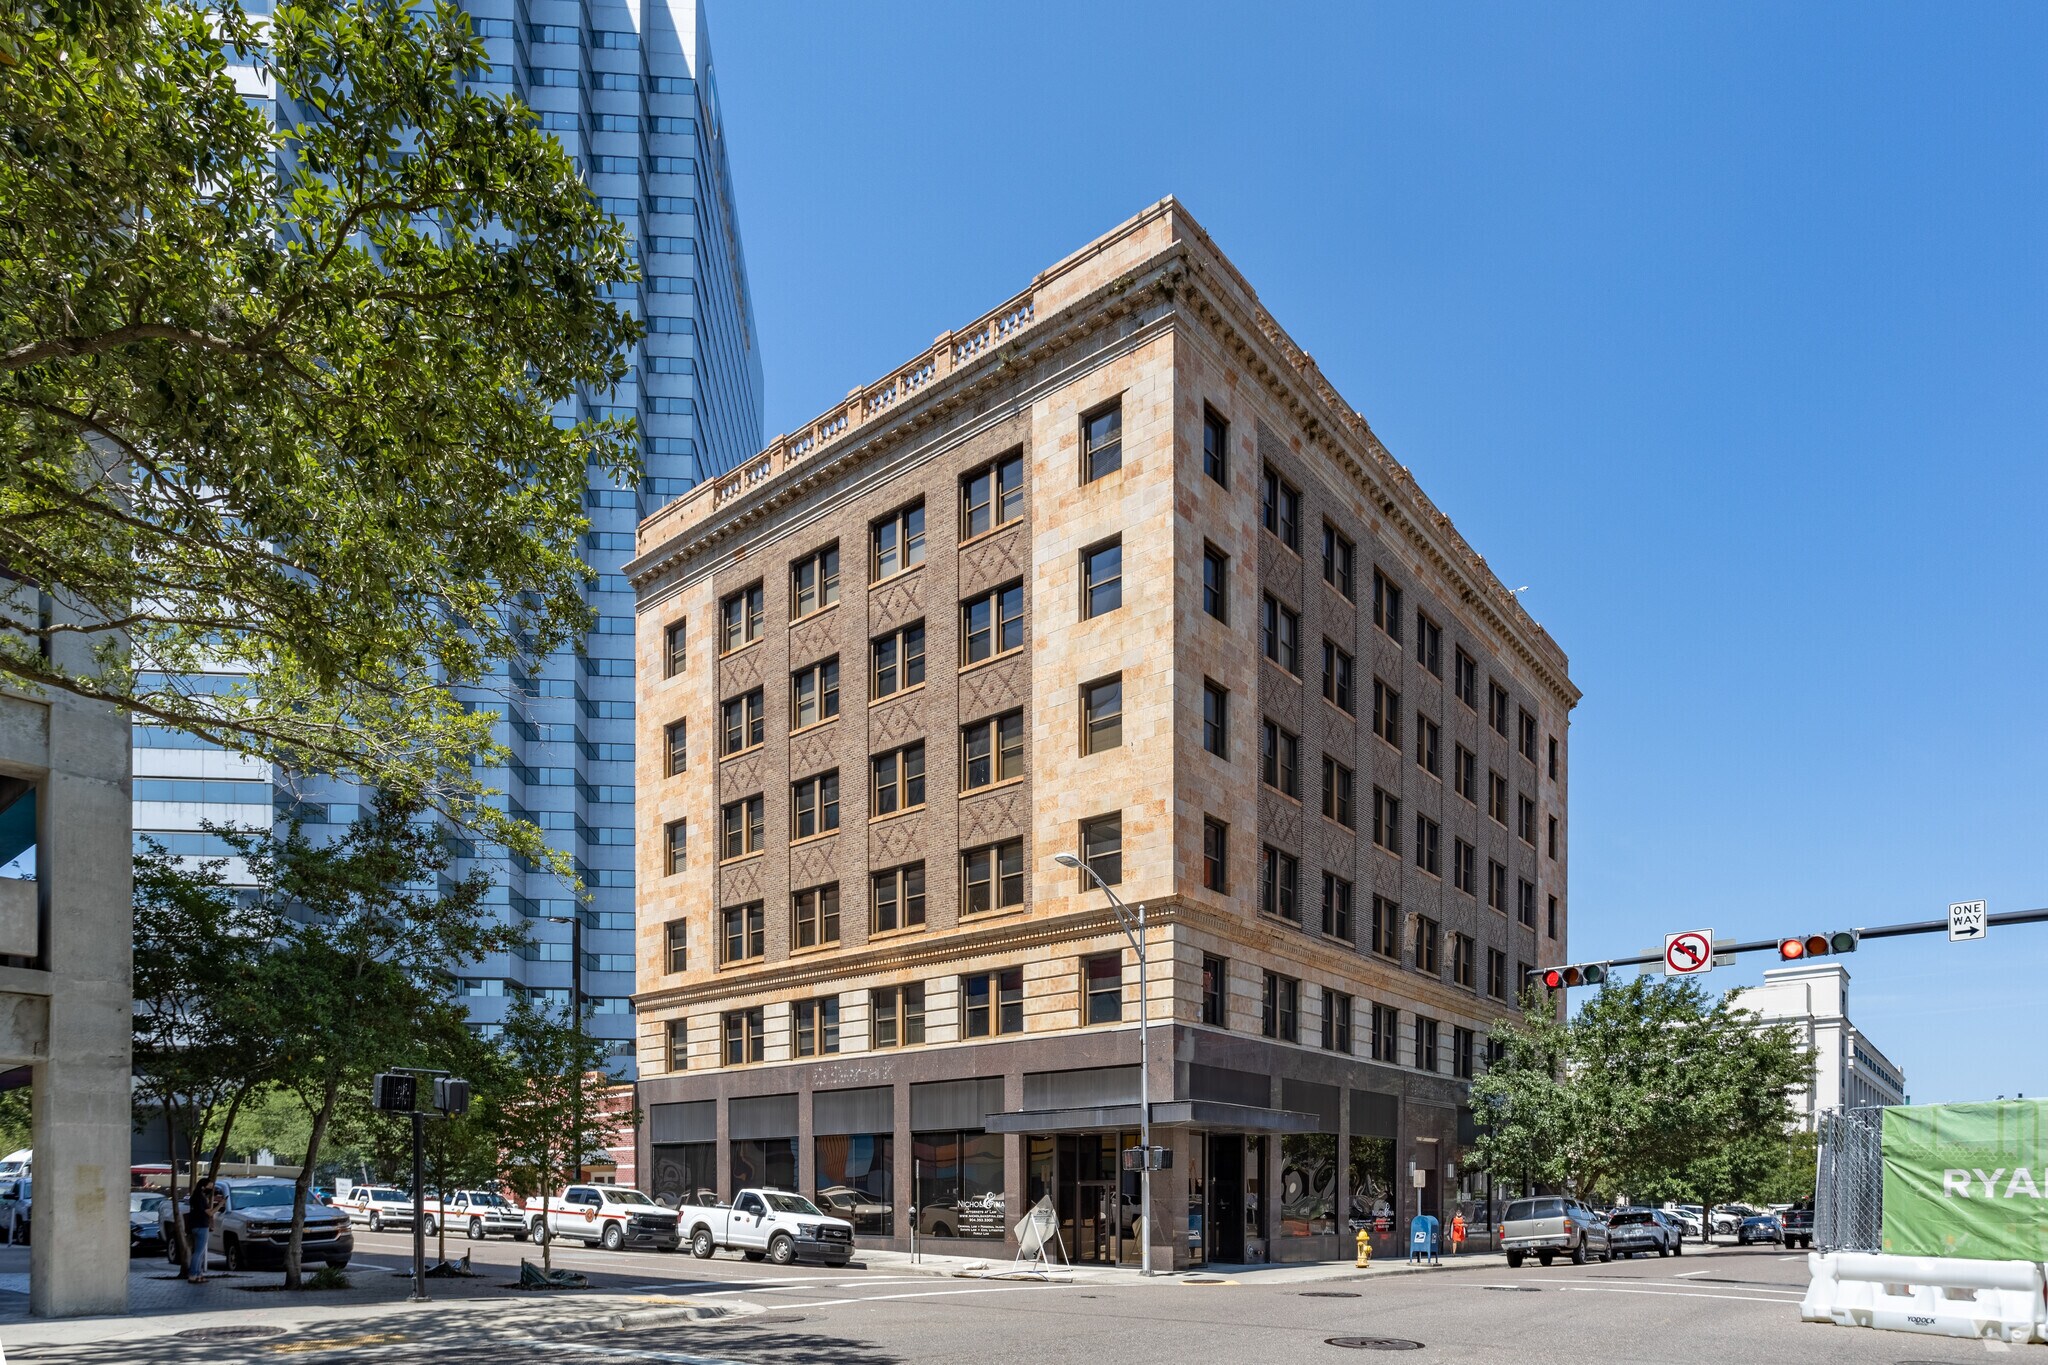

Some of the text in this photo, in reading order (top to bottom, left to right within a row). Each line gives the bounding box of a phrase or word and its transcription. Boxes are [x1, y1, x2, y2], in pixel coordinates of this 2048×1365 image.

[1953, 904, 1981, 915] ONE
[1953, 914, 1982, 926] WAY
[1943, 1167, 2048, 1199] RYA
[1907, 1316, 1936, 1324] YODOCK
